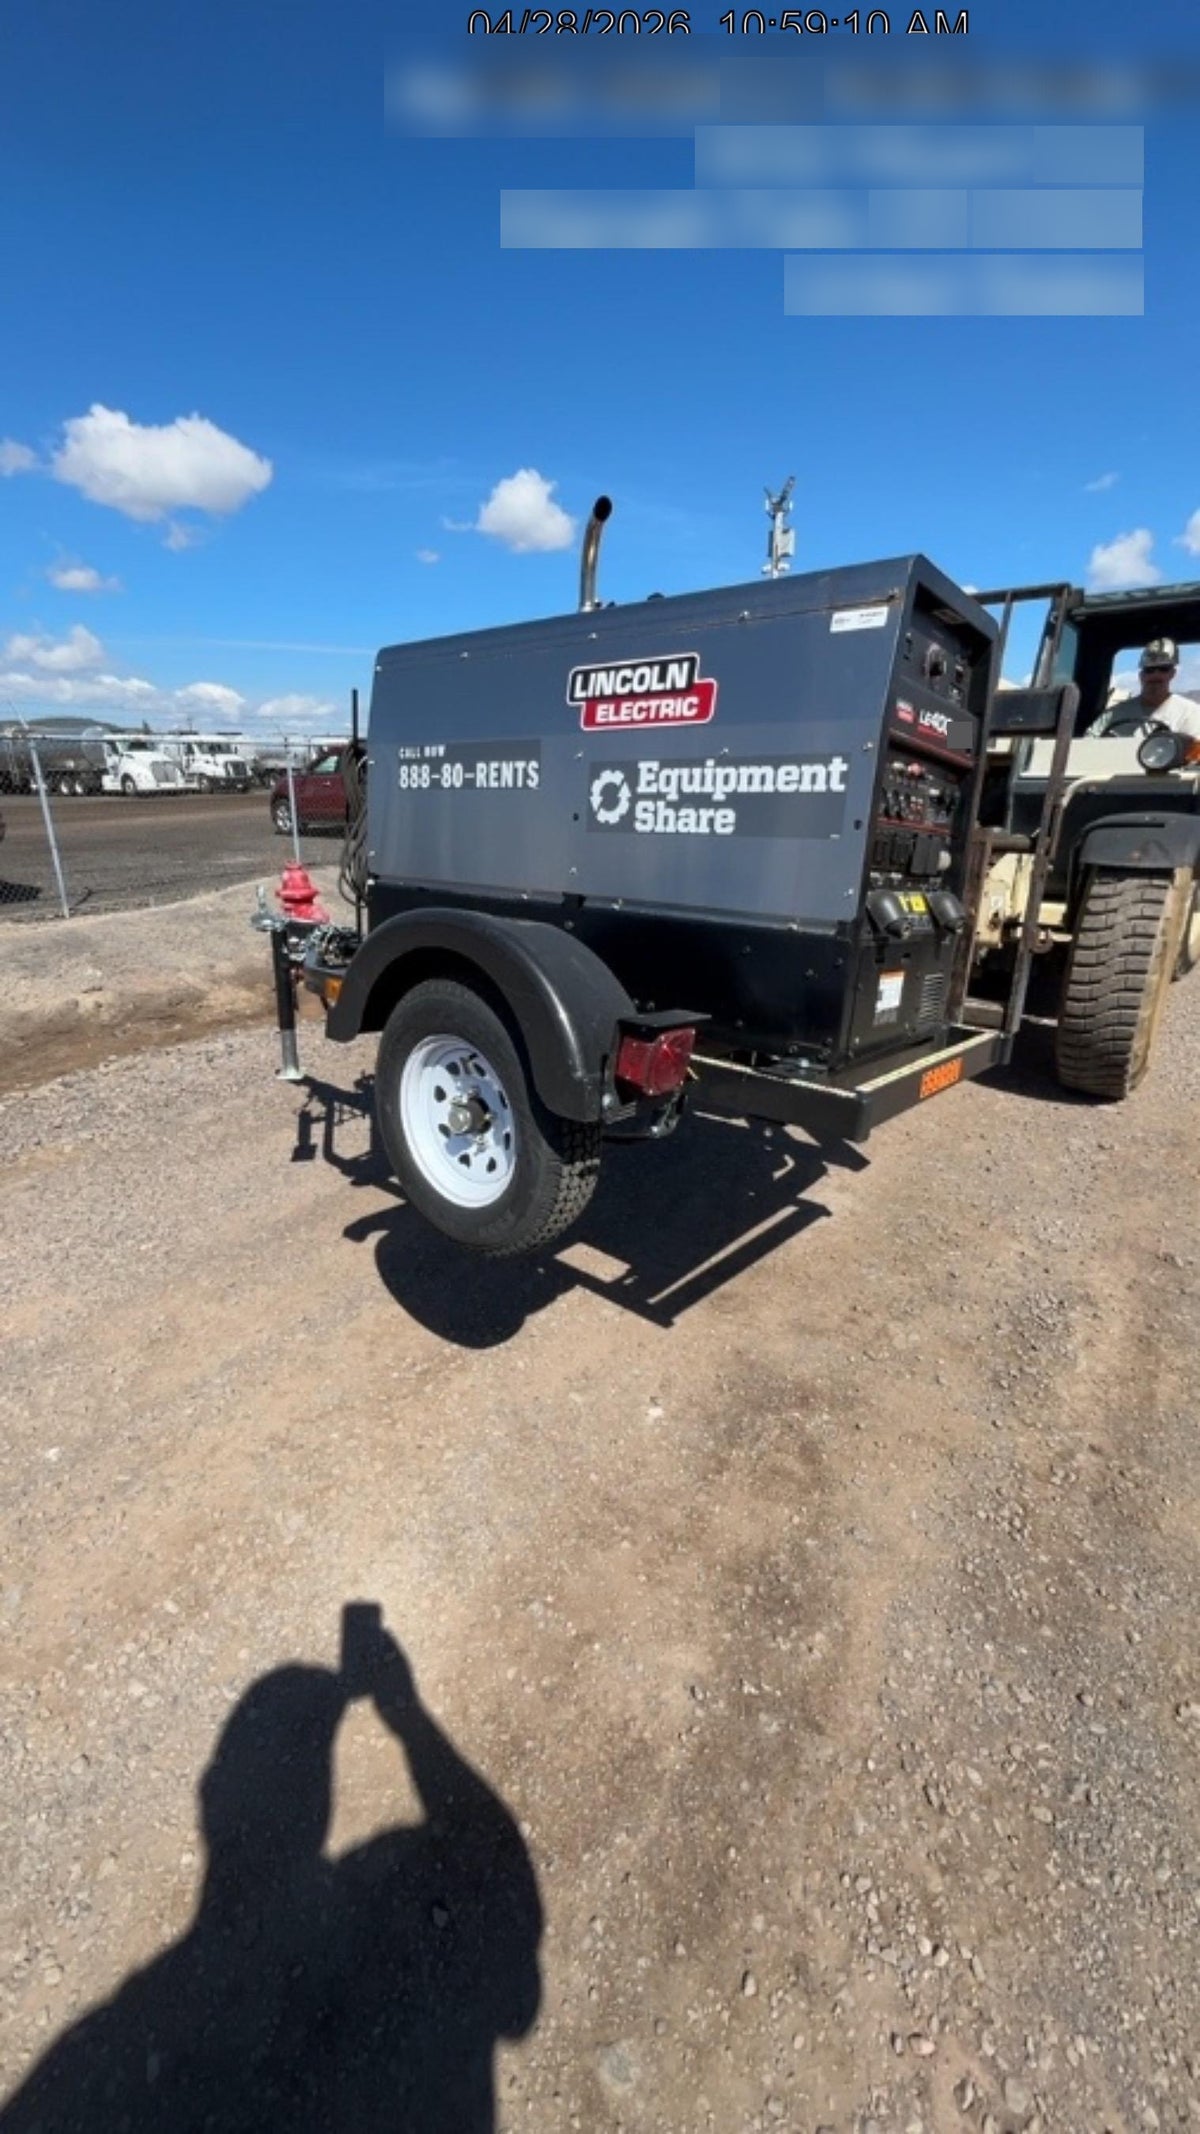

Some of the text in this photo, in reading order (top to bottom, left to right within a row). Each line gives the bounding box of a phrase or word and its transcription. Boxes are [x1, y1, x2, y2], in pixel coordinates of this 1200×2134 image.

[573, 661, 690, 698] LINCOLN
[594, 696, 699, 723] ELECTRIC
[400, 760, 539, 789] 888-80-RENTS
[636, 757, 848, 800] Equipment
[634, 800, 736, 834] Share
